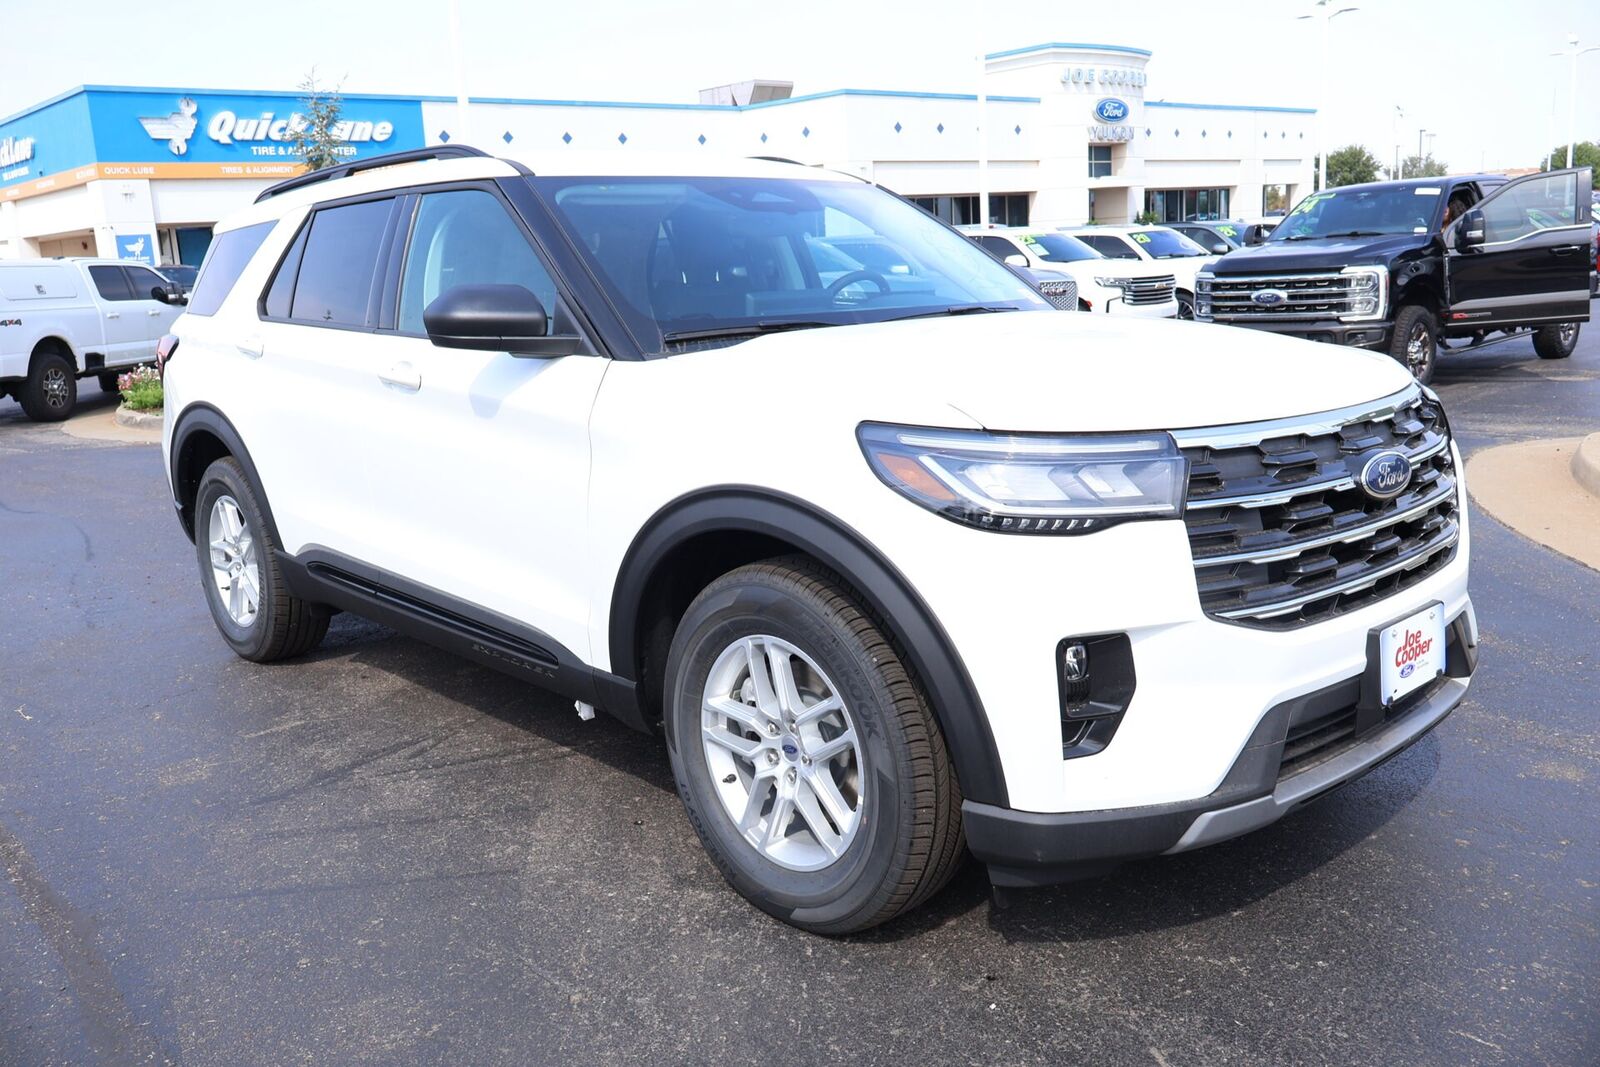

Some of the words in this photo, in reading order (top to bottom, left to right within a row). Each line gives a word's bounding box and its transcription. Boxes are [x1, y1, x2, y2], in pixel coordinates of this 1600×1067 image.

[1061, 67, 1095, 84] JOE
[207, 111, 309, 144] Quick
[1087, 126, 1135, 141] YUKON
[251, 146, 276, 155] TIRE
[278, 146, 286, 155] &
[104, 166, 131, 175] QUICK
[133, 166, 155, 175] LUBE
[221, 166, 243, 174] TIRES
[252, 166, 294, 174] ALIGNMENT
[1378, 462, 1405, 488] Ford
[1402, 629, 1422, 651] Joe
[1395, 637, 1433, 668] Cooper
